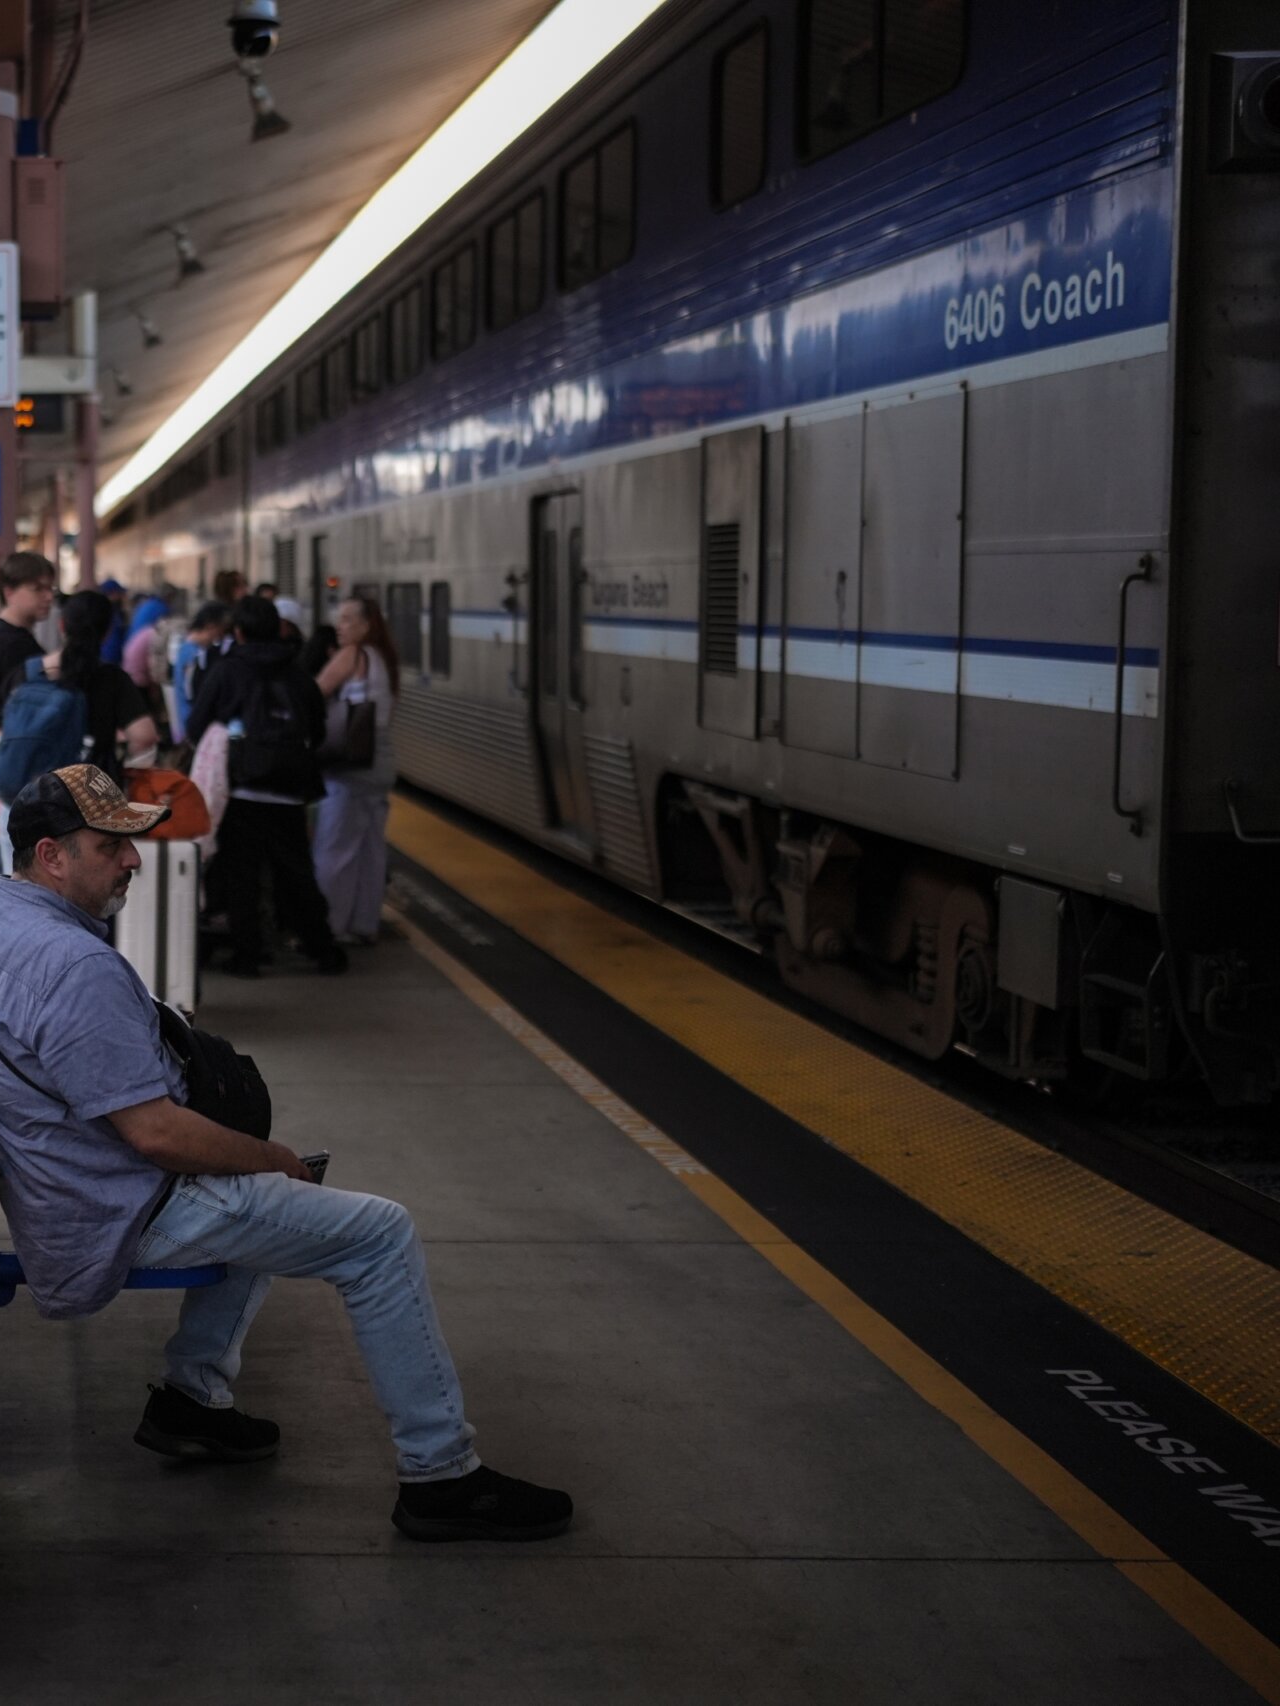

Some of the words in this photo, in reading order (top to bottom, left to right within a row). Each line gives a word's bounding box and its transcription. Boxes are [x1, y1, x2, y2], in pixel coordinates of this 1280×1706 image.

[944, 283, 1006, 350] 6406
[1021, 250, 1125, 331] Coach
[1044, 1369, 1229, 1475] PLEASE
[1197, 1483, 1280, 1547] WA
